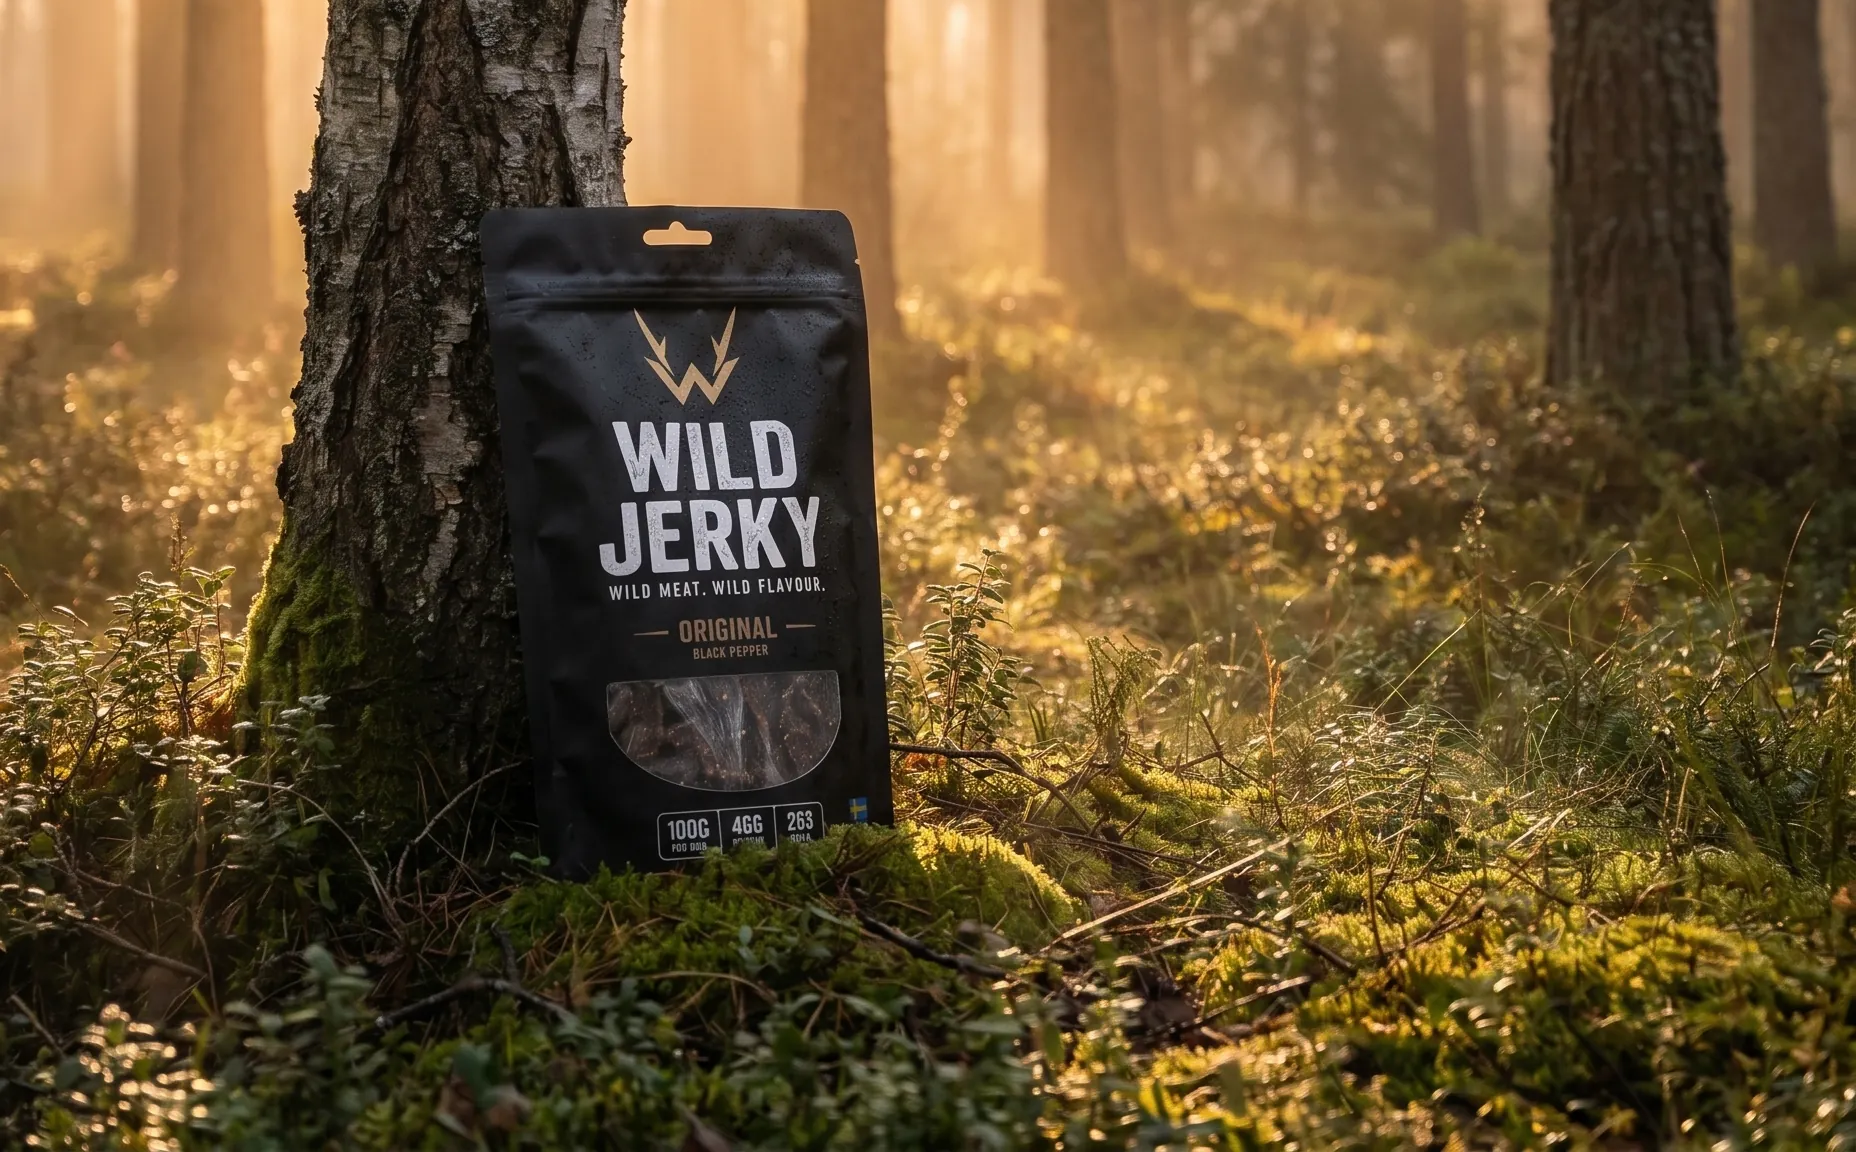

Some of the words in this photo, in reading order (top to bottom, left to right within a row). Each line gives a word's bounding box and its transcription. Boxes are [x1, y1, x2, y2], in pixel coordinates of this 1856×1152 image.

[612, 420, 797, 492] WILD
[599, 496, 820, 576] JERKY
[609, 583, 651, 600] WILD
[659, 581, 707, 598] MEAT.
[712, 579, 751, 596] WILD
[758, 576, 826, 594] FLAVOUR.
[679, 616, 778, 643] ORIGINAL
[693, 647, 726, 660] BLACK
[729, 644, 769, 657] PEPPER
[667, 818, 710, 841] 100G
[787, 810, 814, 831] 263
